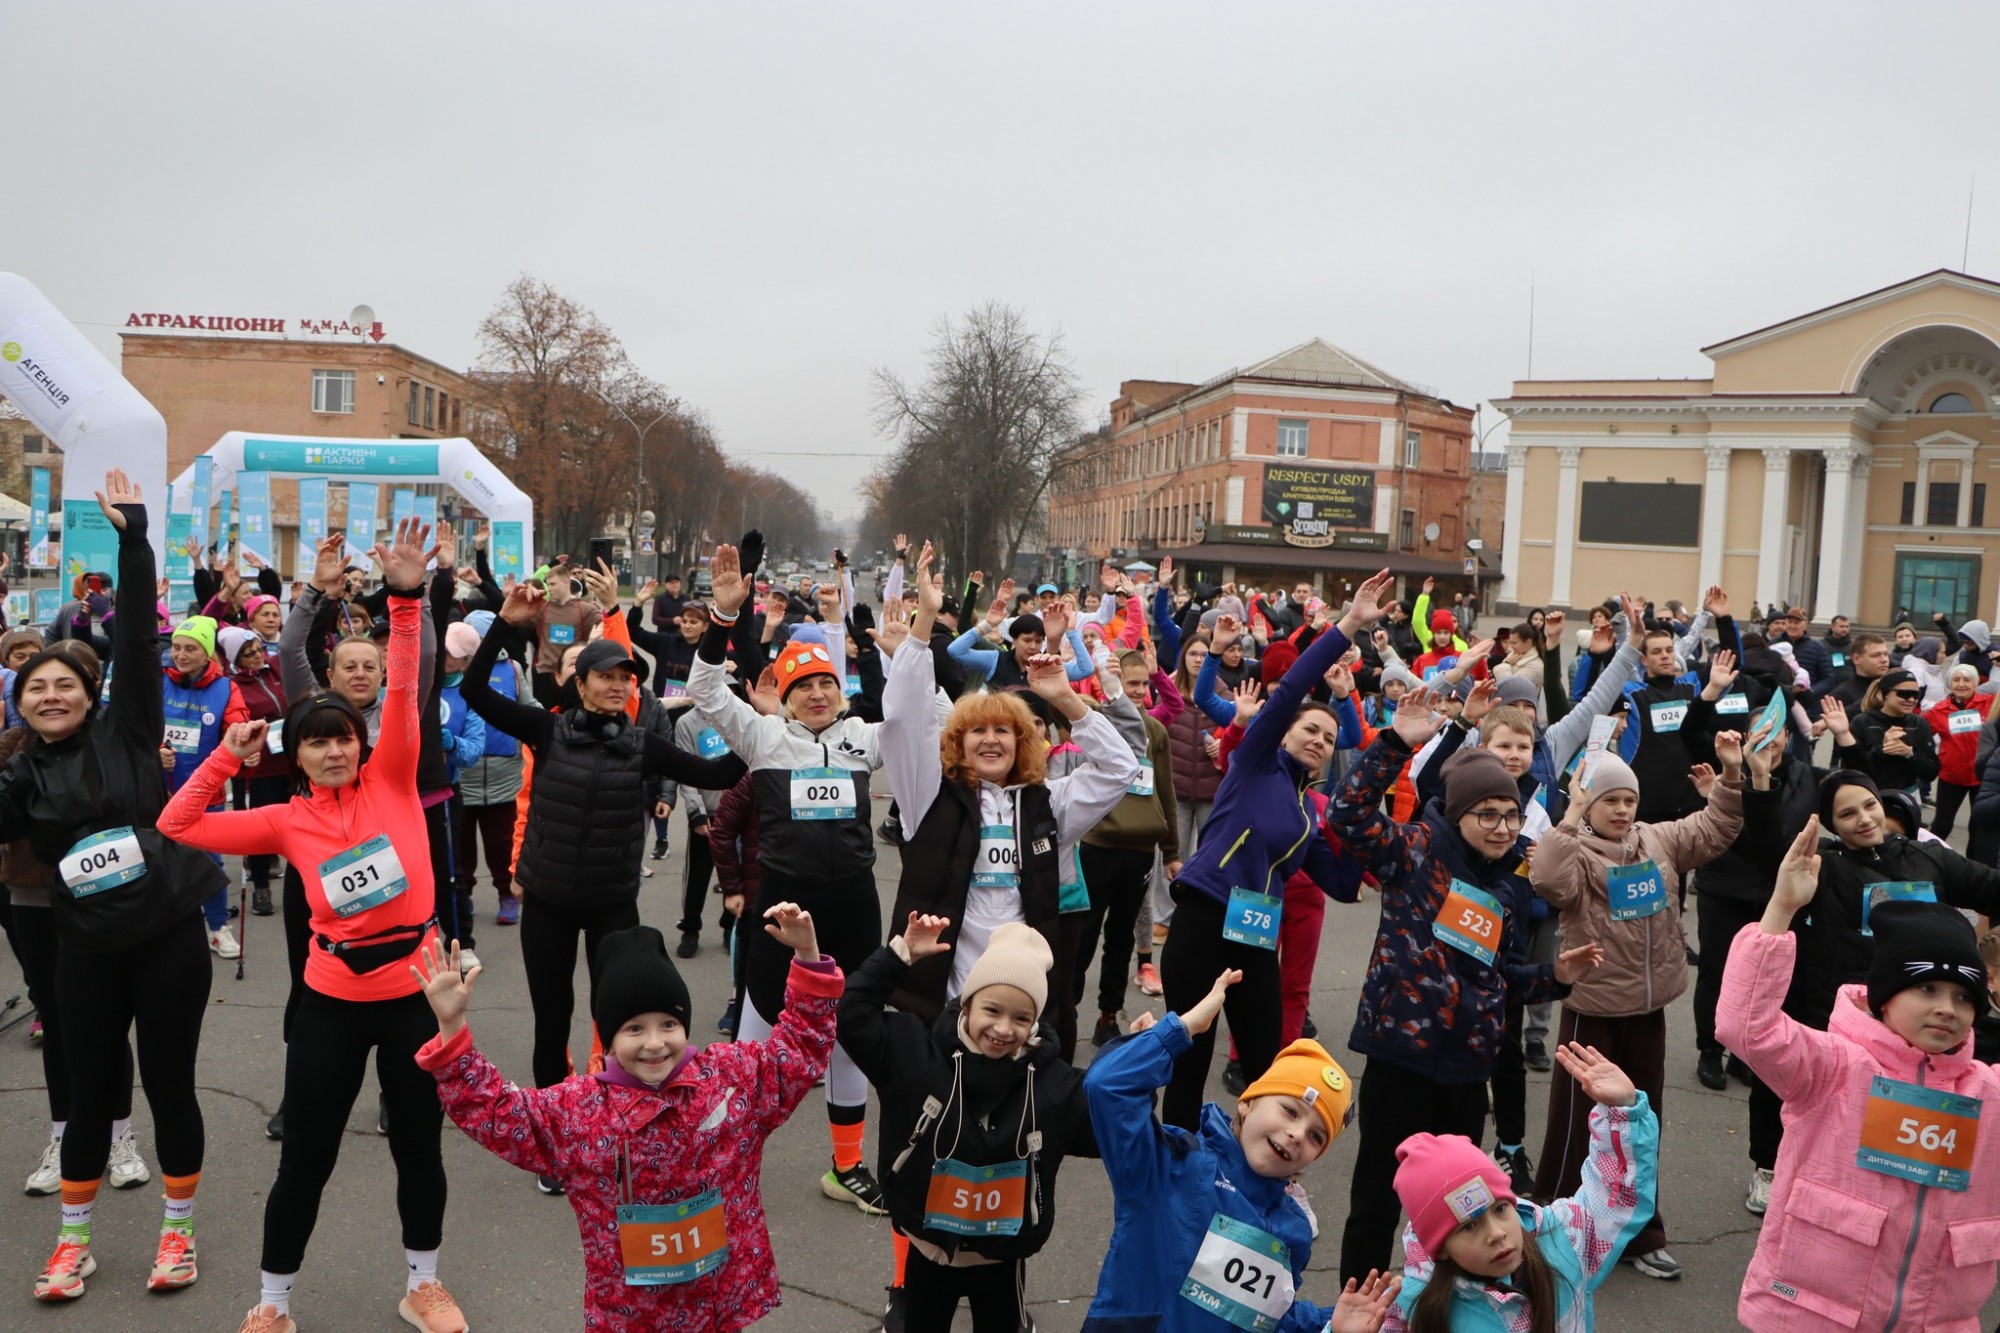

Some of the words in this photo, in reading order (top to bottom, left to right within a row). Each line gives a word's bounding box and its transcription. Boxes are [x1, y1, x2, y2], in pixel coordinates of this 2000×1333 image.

[125, 312, 286, 333] АТРАКЦІОНИ
[20, 358, 70, 405] АГЕНЦІЯ
[322, 447, 377, 457] АКТИВНІ
[322, 456, 365, 465] ПАРКИ
[1268, 468, 1329, 484] RESPECT
[1333, 473, 1370, 487] USDT
[1661, 711, 1680, 721] 024
[1956, 716, 1973, 725] 436
[166, 730, 189, 741] 422
[807, 785, 840, 801] 020
[80, 847, 120, 874] 004
[988, 847, 1018, 865] 006
[341, 864, 380, 893] 031
[1627, 878, 1657, 900] 598
[1241, 908, 1272, 930] 578
[1458, 908, 1494, 938] 523
[1896, 1117, 1957, 1155] 564
[1867, 1155, 1906, 1171] ДИТЯЧИЙ
[1906, 1165, 1930, 1177] ЗАБІГ
[1214, 1179, 1236, 1193] erima
[952, 1187, 1001, 1212] 510
[930, 1218, 960, 1229] ДИТЯЧИЙ
[650, 1226, 701, 1256] 511
[634, 1271, 666, 1280] ДИТЯЧИЙ
[667, 1270, 685, 1278] ЗАБІГ
[1223, 1257, 1276, 1300] 021
